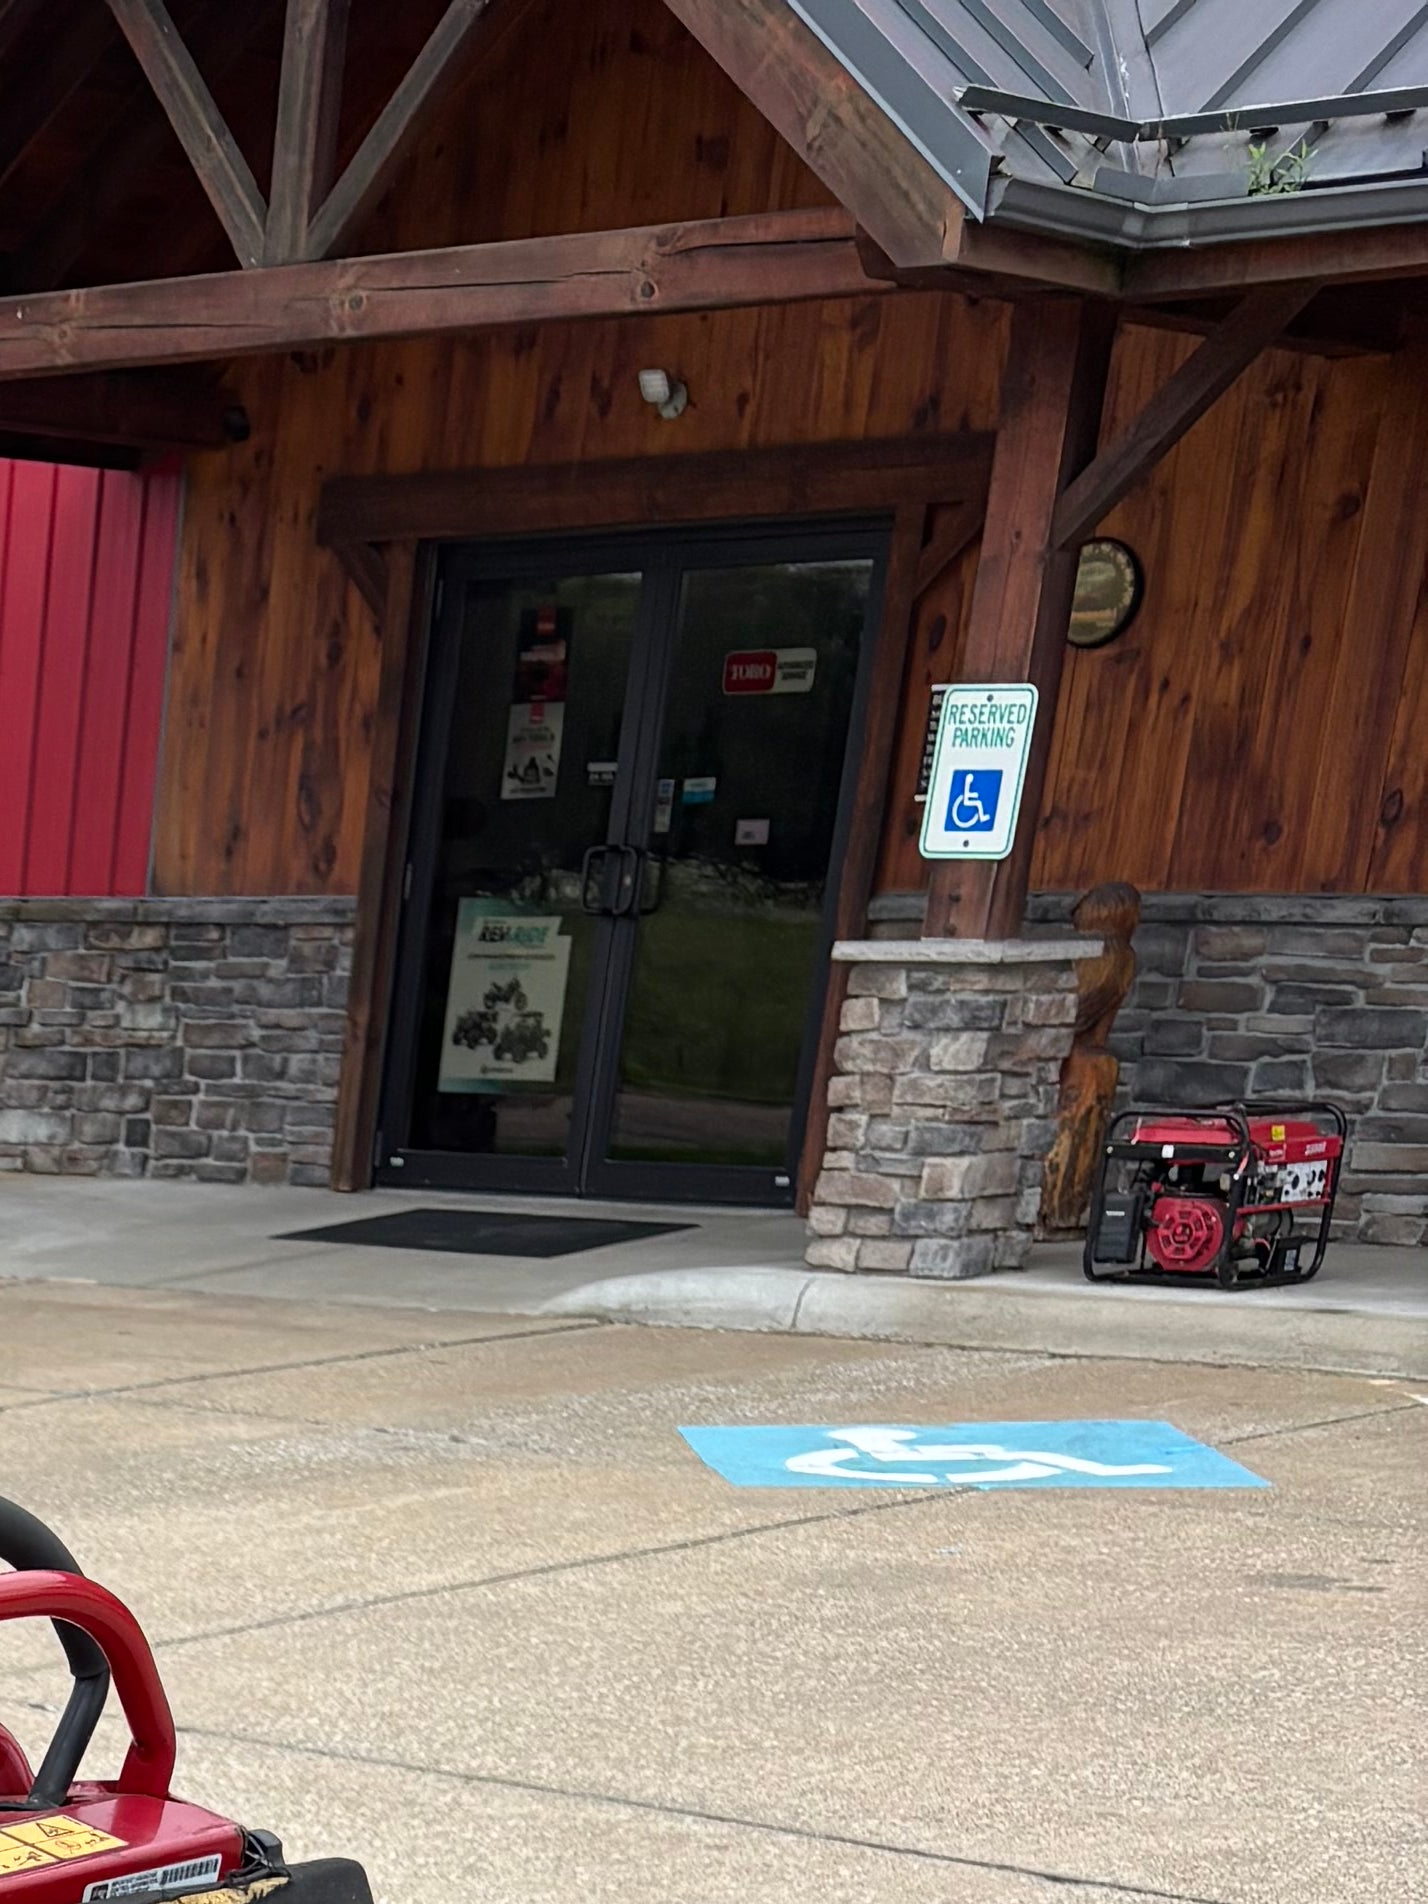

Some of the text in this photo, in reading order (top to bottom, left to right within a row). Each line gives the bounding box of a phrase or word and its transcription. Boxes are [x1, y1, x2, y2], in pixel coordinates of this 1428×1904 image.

[728, 663, 772, 681] TORO
[948, 703, 1027, 725] RESERVED
[952, 727, 1016, 748] PARKING
